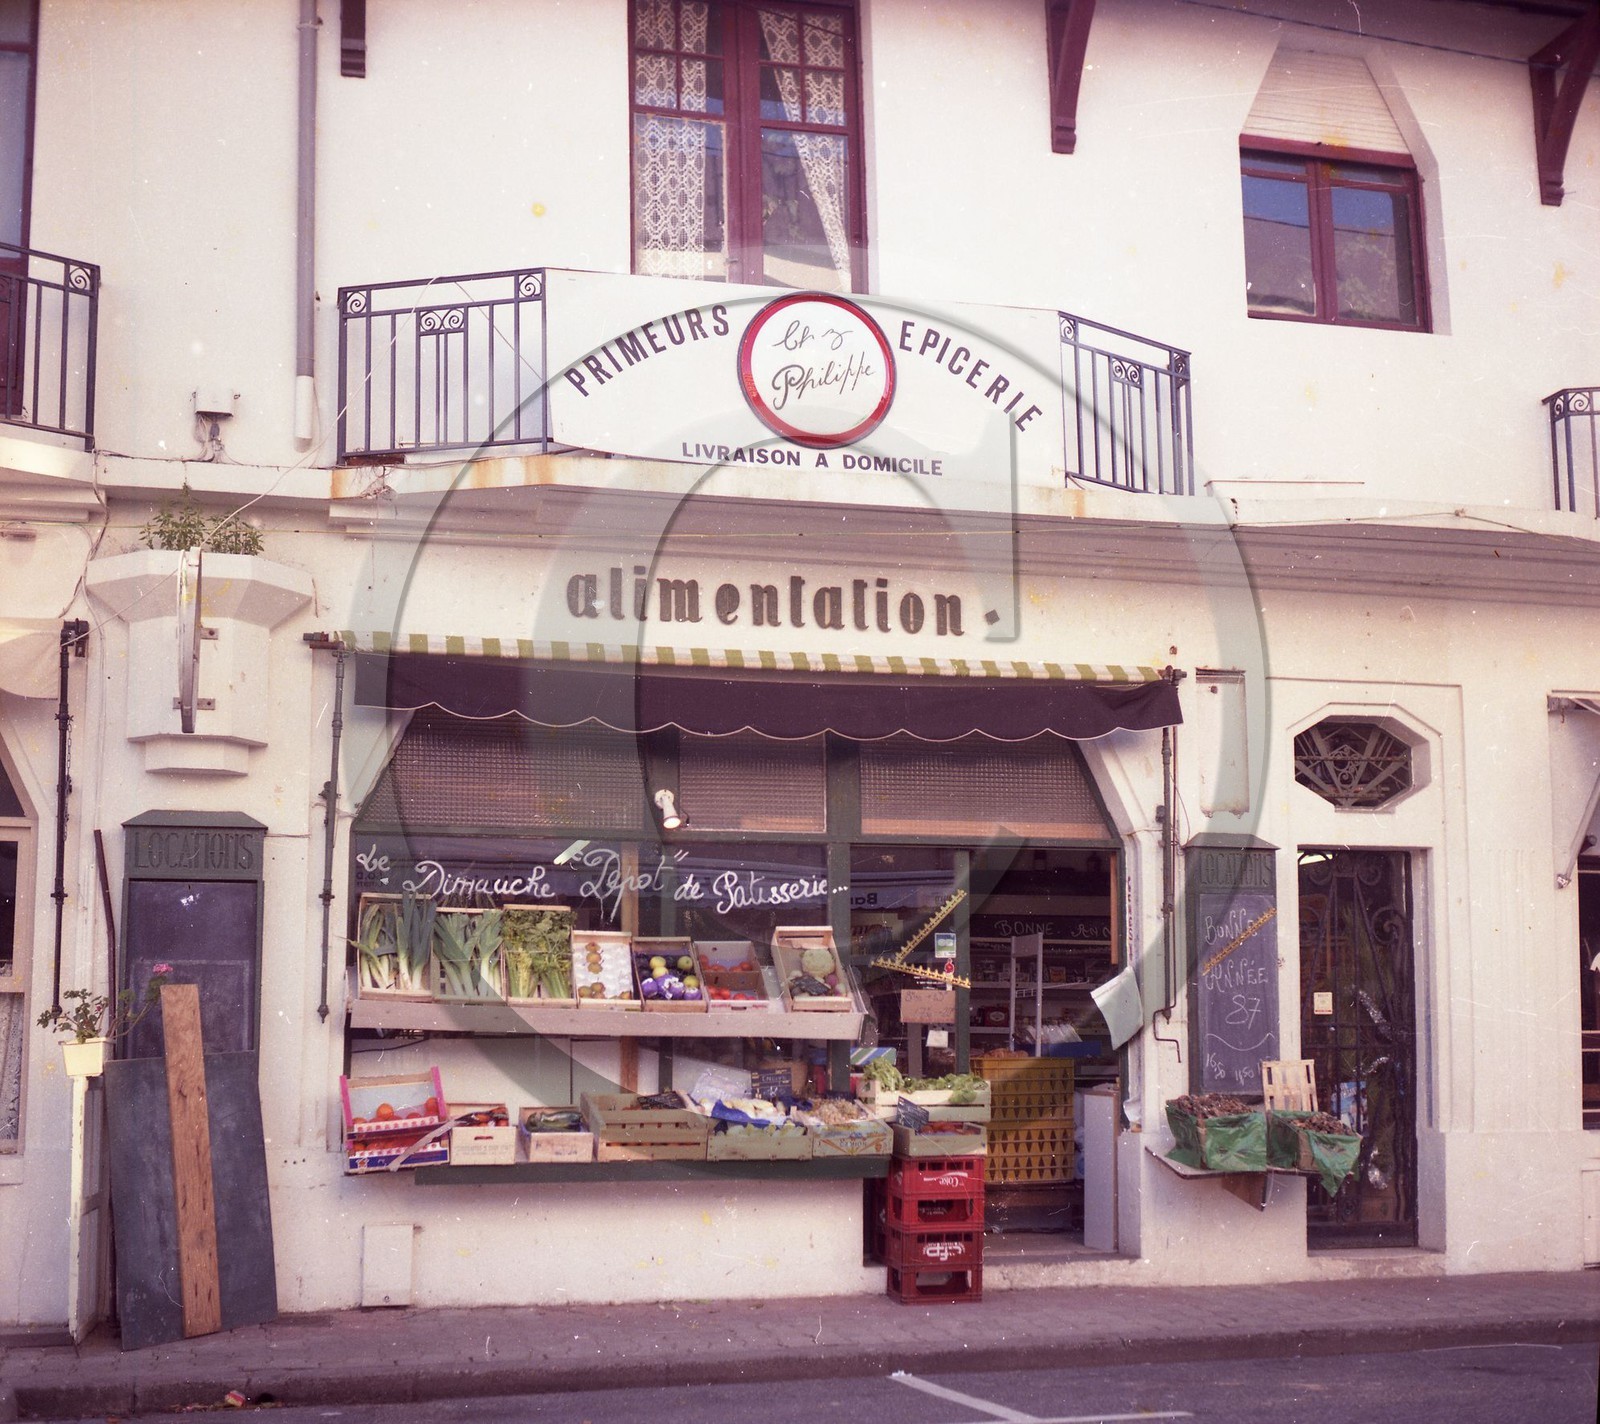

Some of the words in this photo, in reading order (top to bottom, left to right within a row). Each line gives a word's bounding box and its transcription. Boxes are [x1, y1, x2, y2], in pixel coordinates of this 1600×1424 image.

[563, 305, 730, 398] PRIMEURS
[899, 321, 1043, 433] EPICERIE
[771, 351, 877, 411] Philippe
[681, 442, 801, 467] LIVRAISON
[815, 453, 830, 469] A
[842, 454, 943, 477] DOMICILE
[356, 844, 390, 872] Le
[674, 873, 704, 901] de
[1225, 994, 1261, 1030] 87
[938, 1176, 960, 1188] Coke
